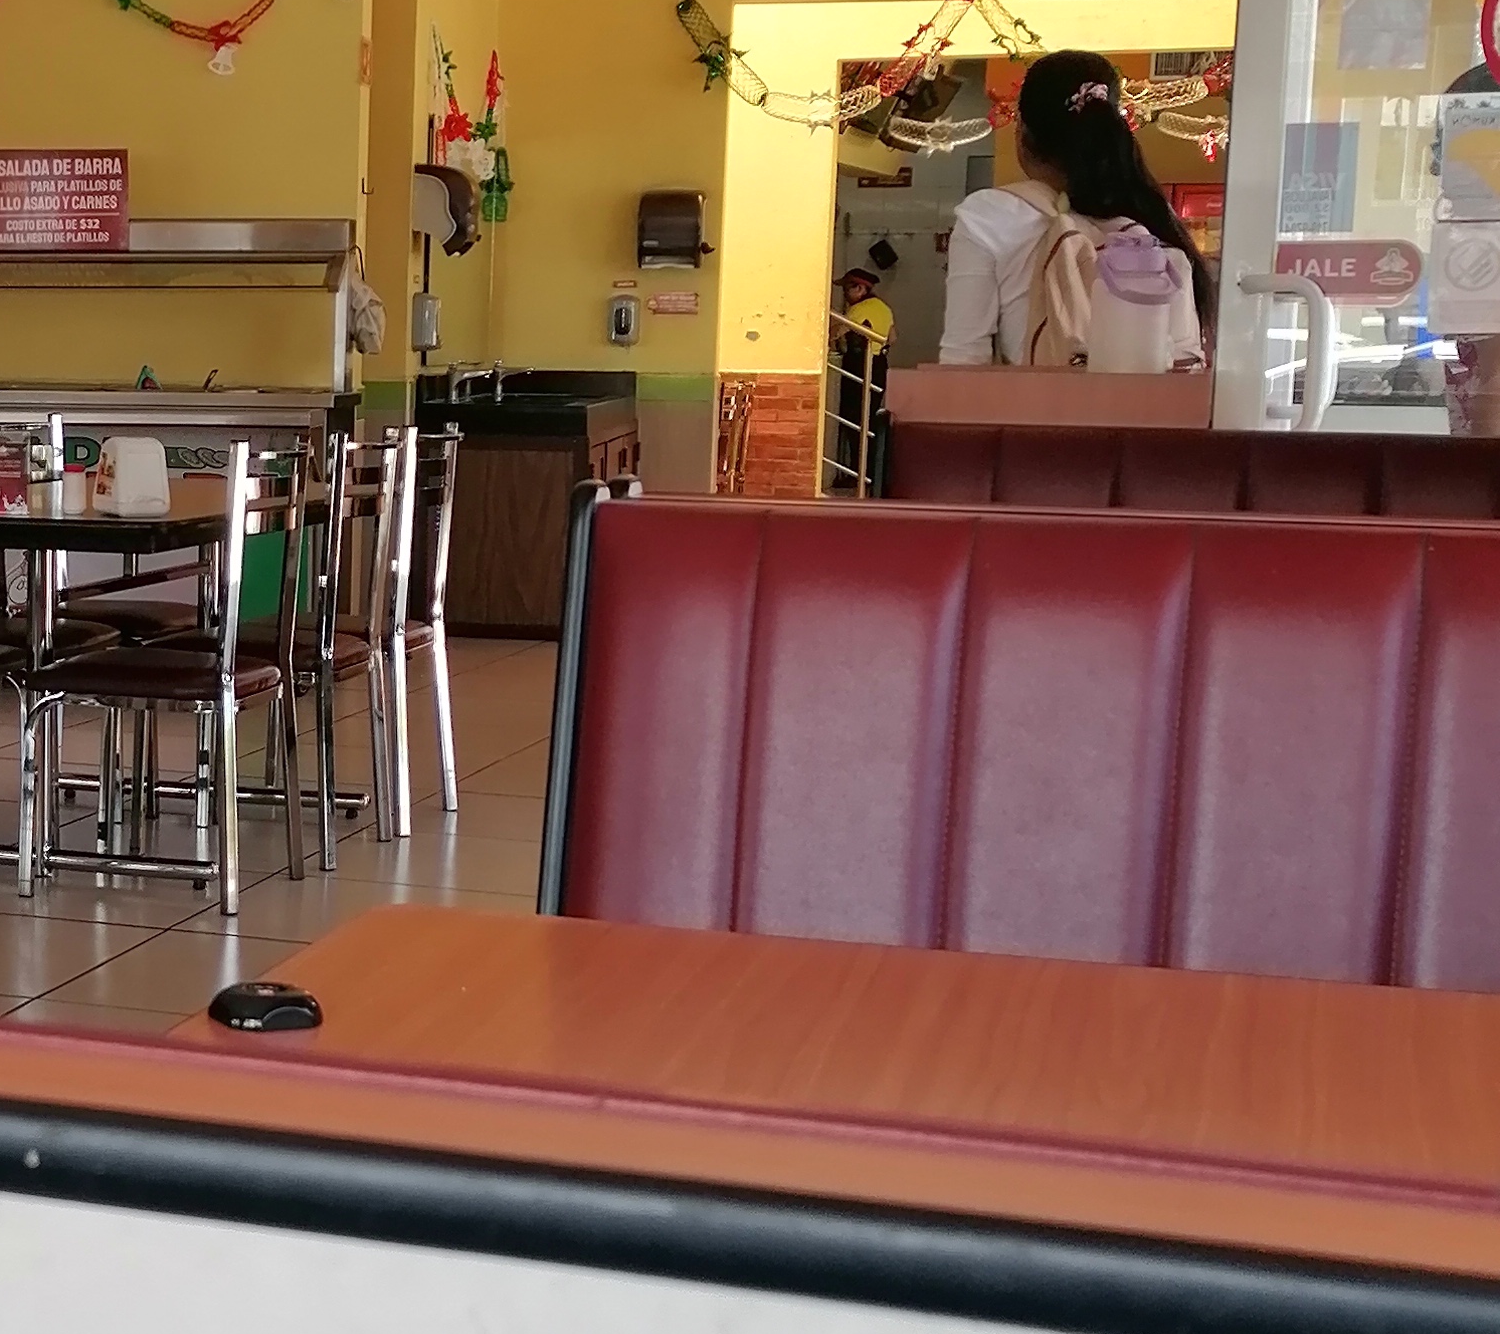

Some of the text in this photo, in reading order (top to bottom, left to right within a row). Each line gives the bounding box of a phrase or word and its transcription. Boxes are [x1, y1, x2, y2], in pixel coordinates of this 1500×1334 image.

[52, 159, 72, 176] DE
[74, 157, 122, 175] BARRA
[31, 180, 56, 193] PARA
[57, 179, 108, 192] PLATILLOS
[109, 179, 122, 192] DE
[23, 196, 60, 211] ASADO
[62, 196, 69, 210] Y
[71, 195, 118, 210] CARNES
[6, 218, 100, 231] COSTO EXTRA DE $32
[16, 233, 26, 243] EL
[26, 232, 53, 243] RESTO
[54, 232, 66, 243] DE
[66, 231, 110, 243] PLATILLOS
[1287, 258, 1357, 278] JALE
